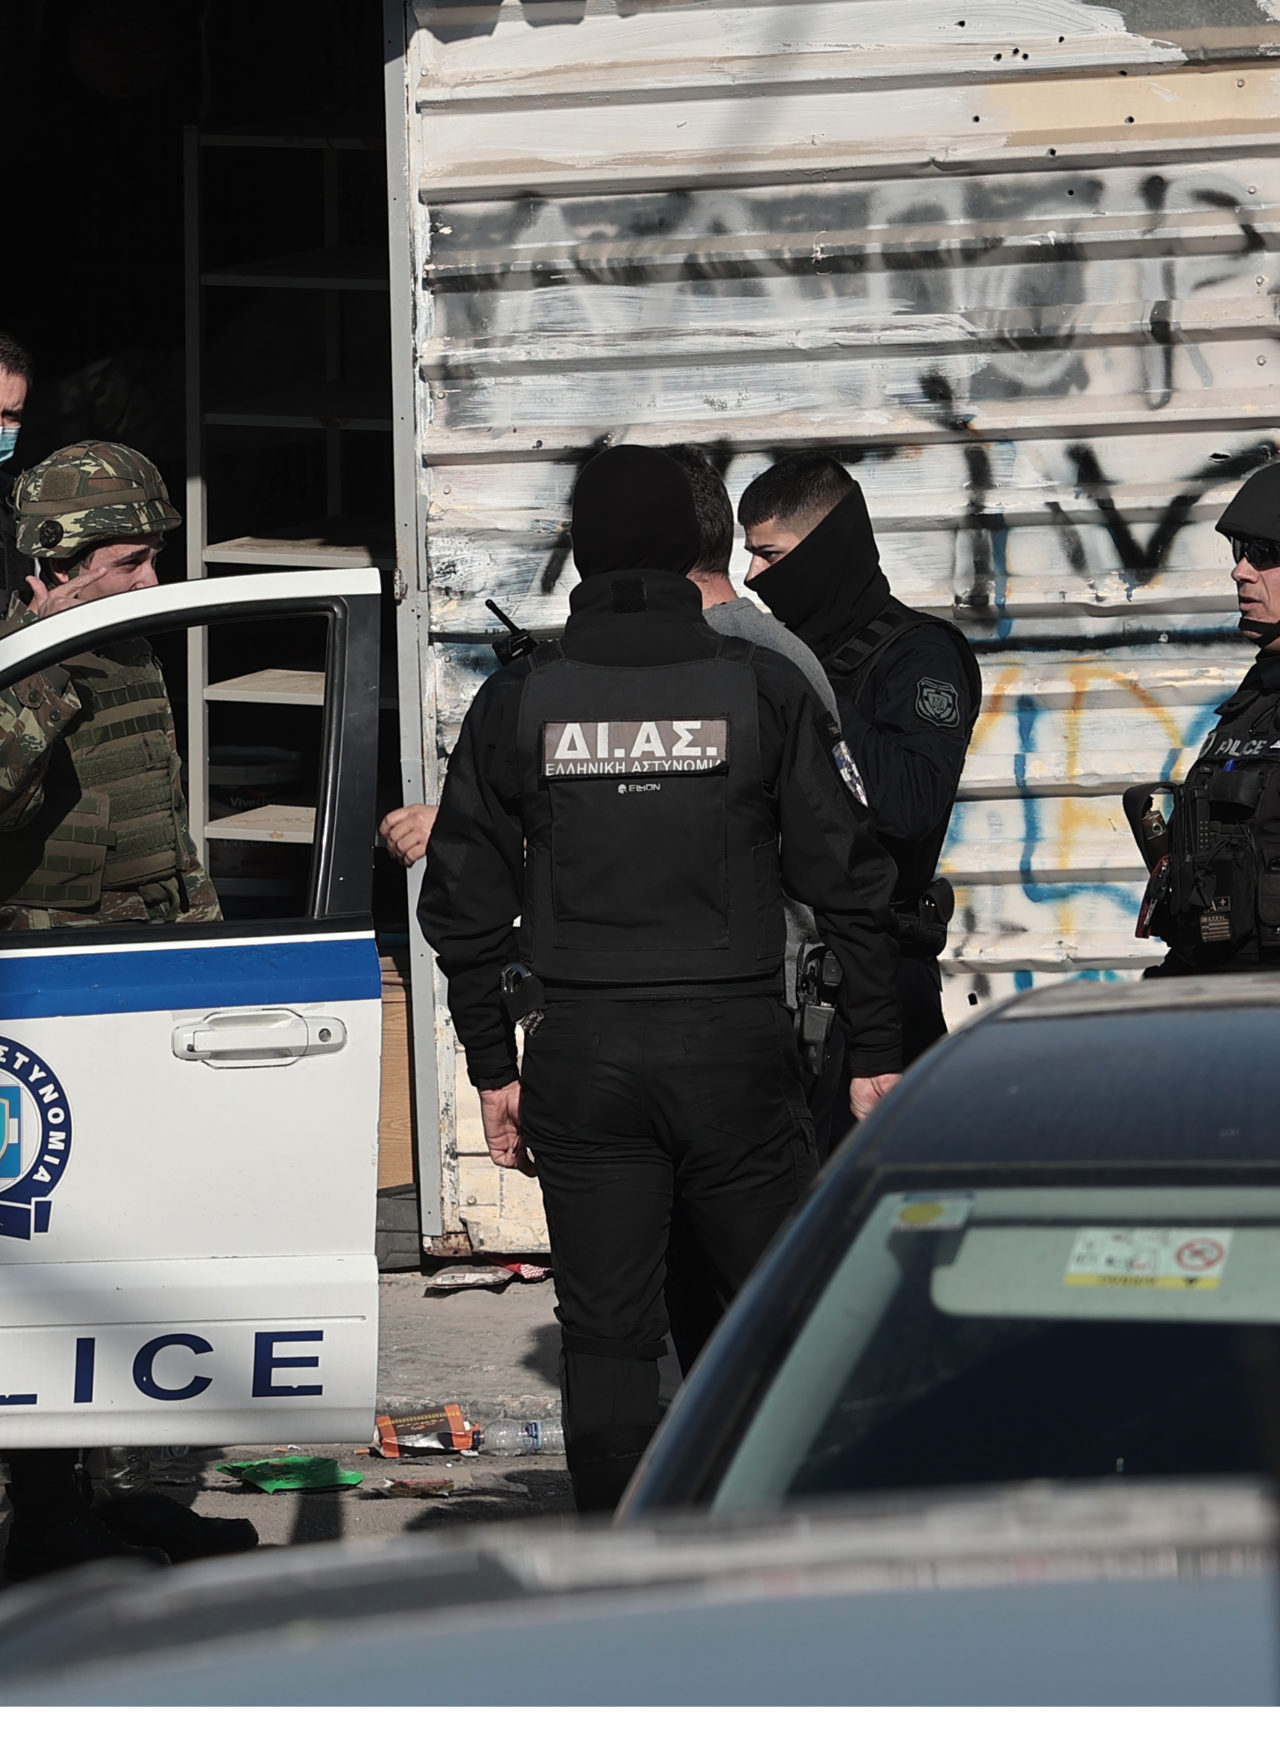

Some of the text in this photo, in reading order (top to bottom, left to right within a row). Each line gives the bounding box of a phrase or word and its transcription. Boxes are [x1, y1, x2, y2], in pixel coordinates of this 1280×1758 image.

[554, 720, 718, 759] ΔΙ.ΑΣ.
[1214, 738, 1268, 757] POLCE
[545, 762, 626, 777] ΕΛΛΗΝΙΚΗ
